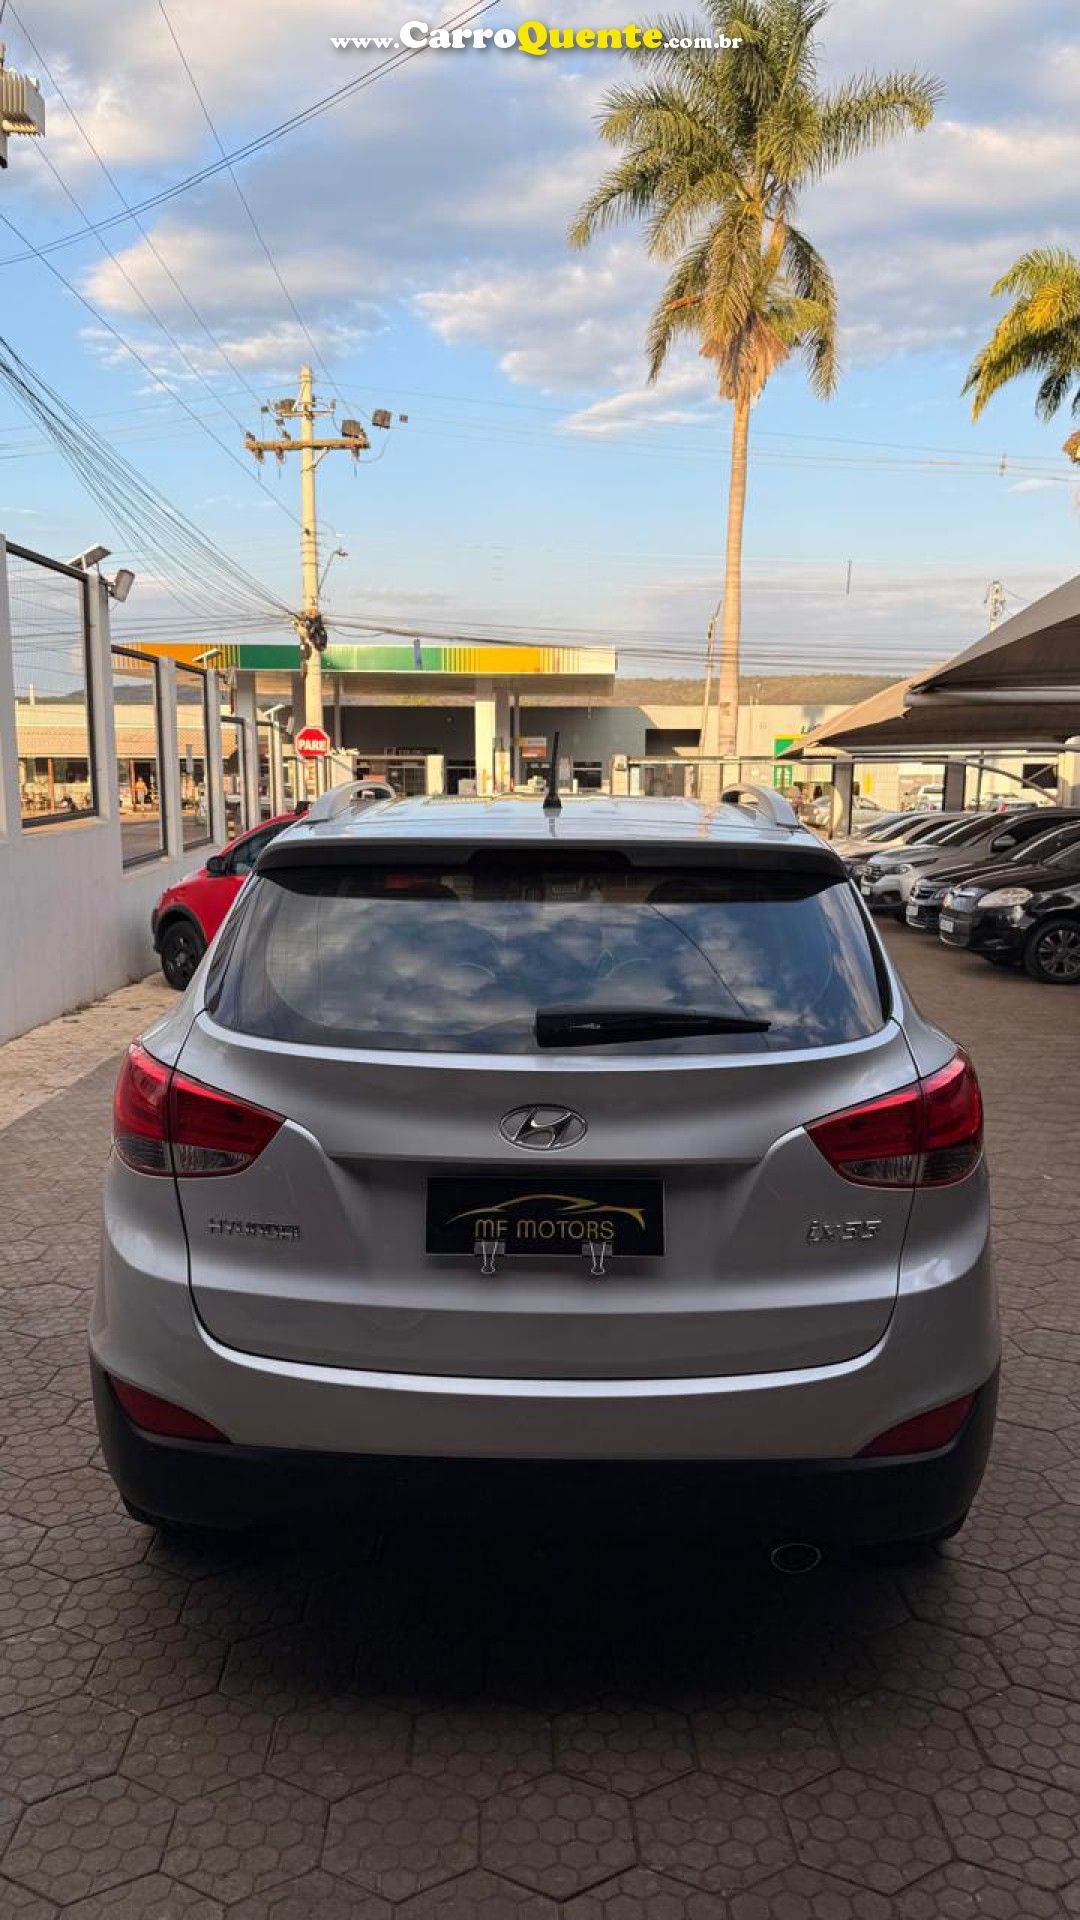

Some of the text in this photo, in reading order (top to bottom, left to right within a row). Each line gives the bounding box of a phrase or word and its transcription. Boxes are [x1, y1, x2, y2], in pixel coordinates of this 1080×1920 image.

[298, 738, 327, 751] PARE
[475, 1219, 614, 1239] MF MOTORS
